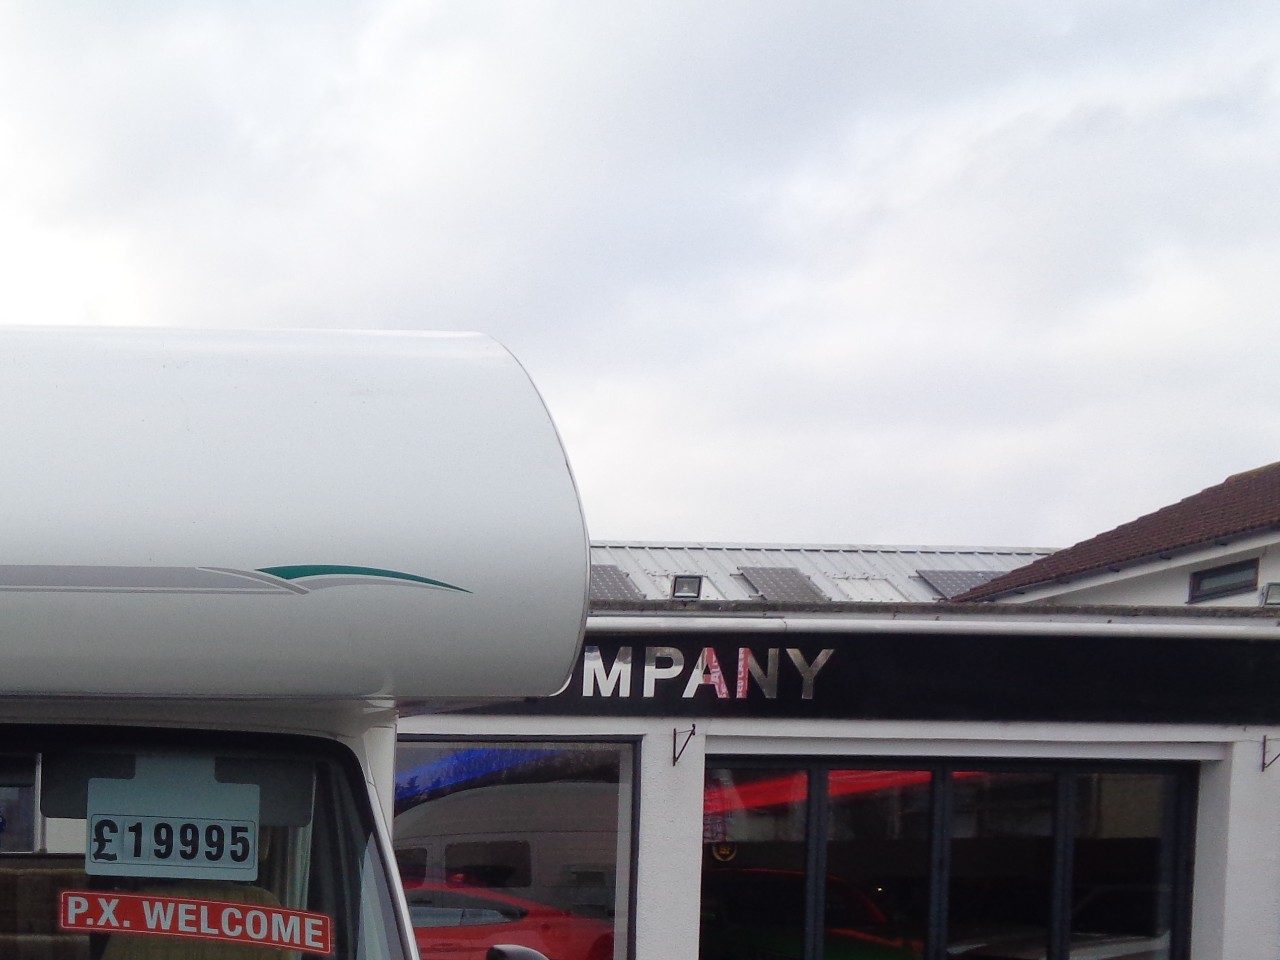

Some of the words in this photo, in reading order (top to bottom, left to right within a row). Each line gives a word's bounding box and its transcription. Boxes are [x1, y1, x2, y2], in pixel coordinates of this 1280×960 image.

[549, 645, 835, 700] MPANY
[93, 819, 250, 863] £19995
[68, 896, 131, 928] P.X.
[143, 900, 324, 949] WELCOME
